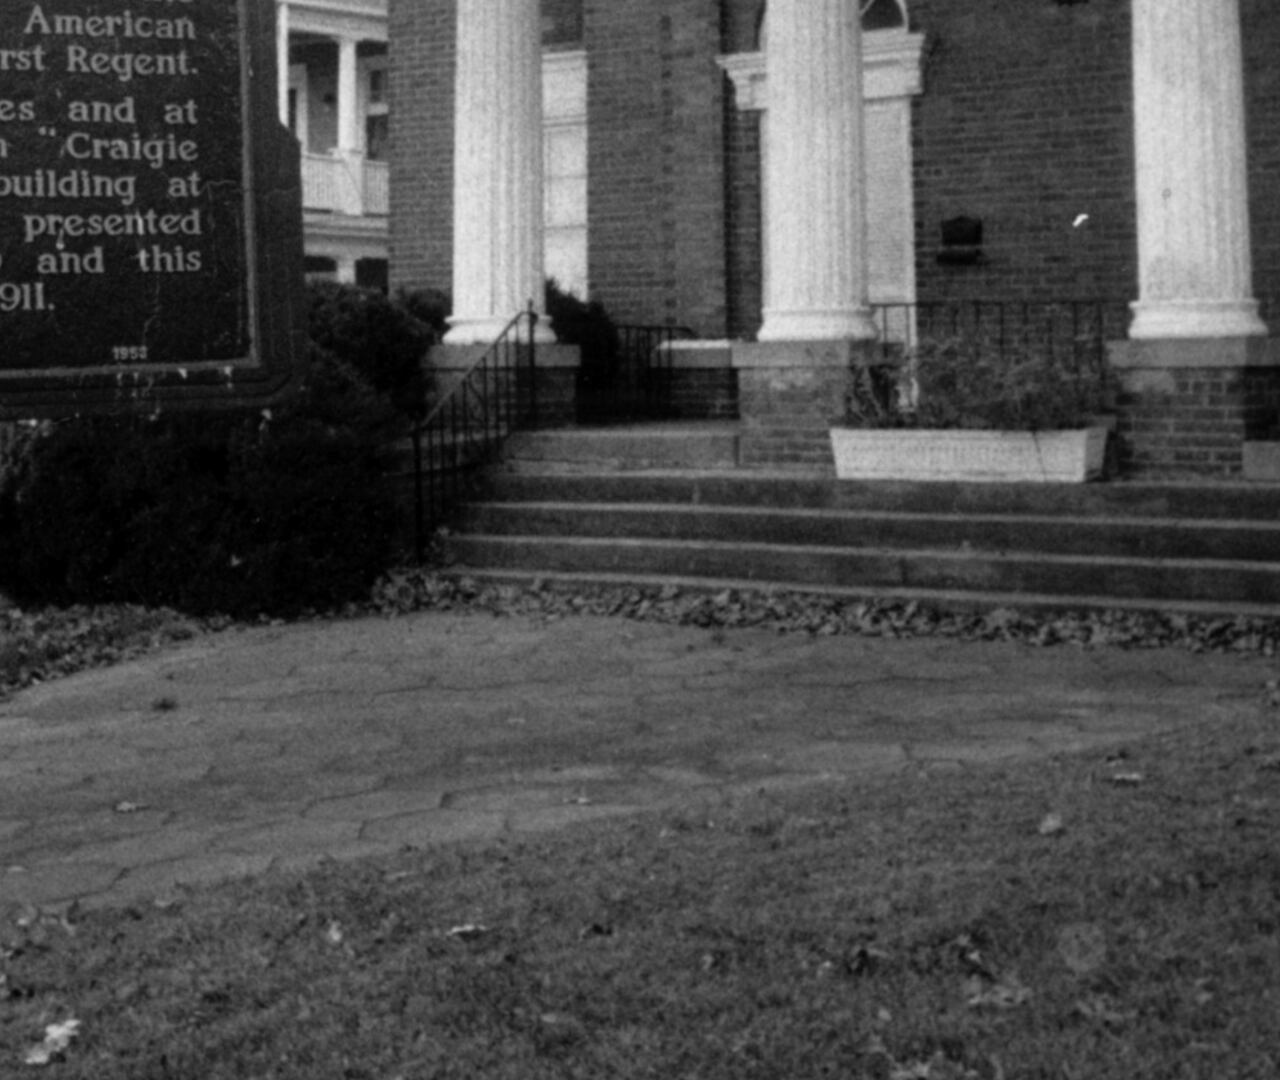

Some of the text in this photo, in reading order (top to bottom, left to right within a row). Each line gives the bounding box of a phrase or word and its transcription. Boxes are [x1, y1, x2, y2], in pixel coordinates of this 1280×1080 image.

[23, 4, 195, 39] American
[67, 43, 198, 83] Regent.
[68, 96, 136, 124] and
[164, 99, 198, 124] at
[167, 171, 200, 198] at
[23, 210, 201, 244] presented
[37, 246, 104, 274] and
[136, 244, 201, 272] this
